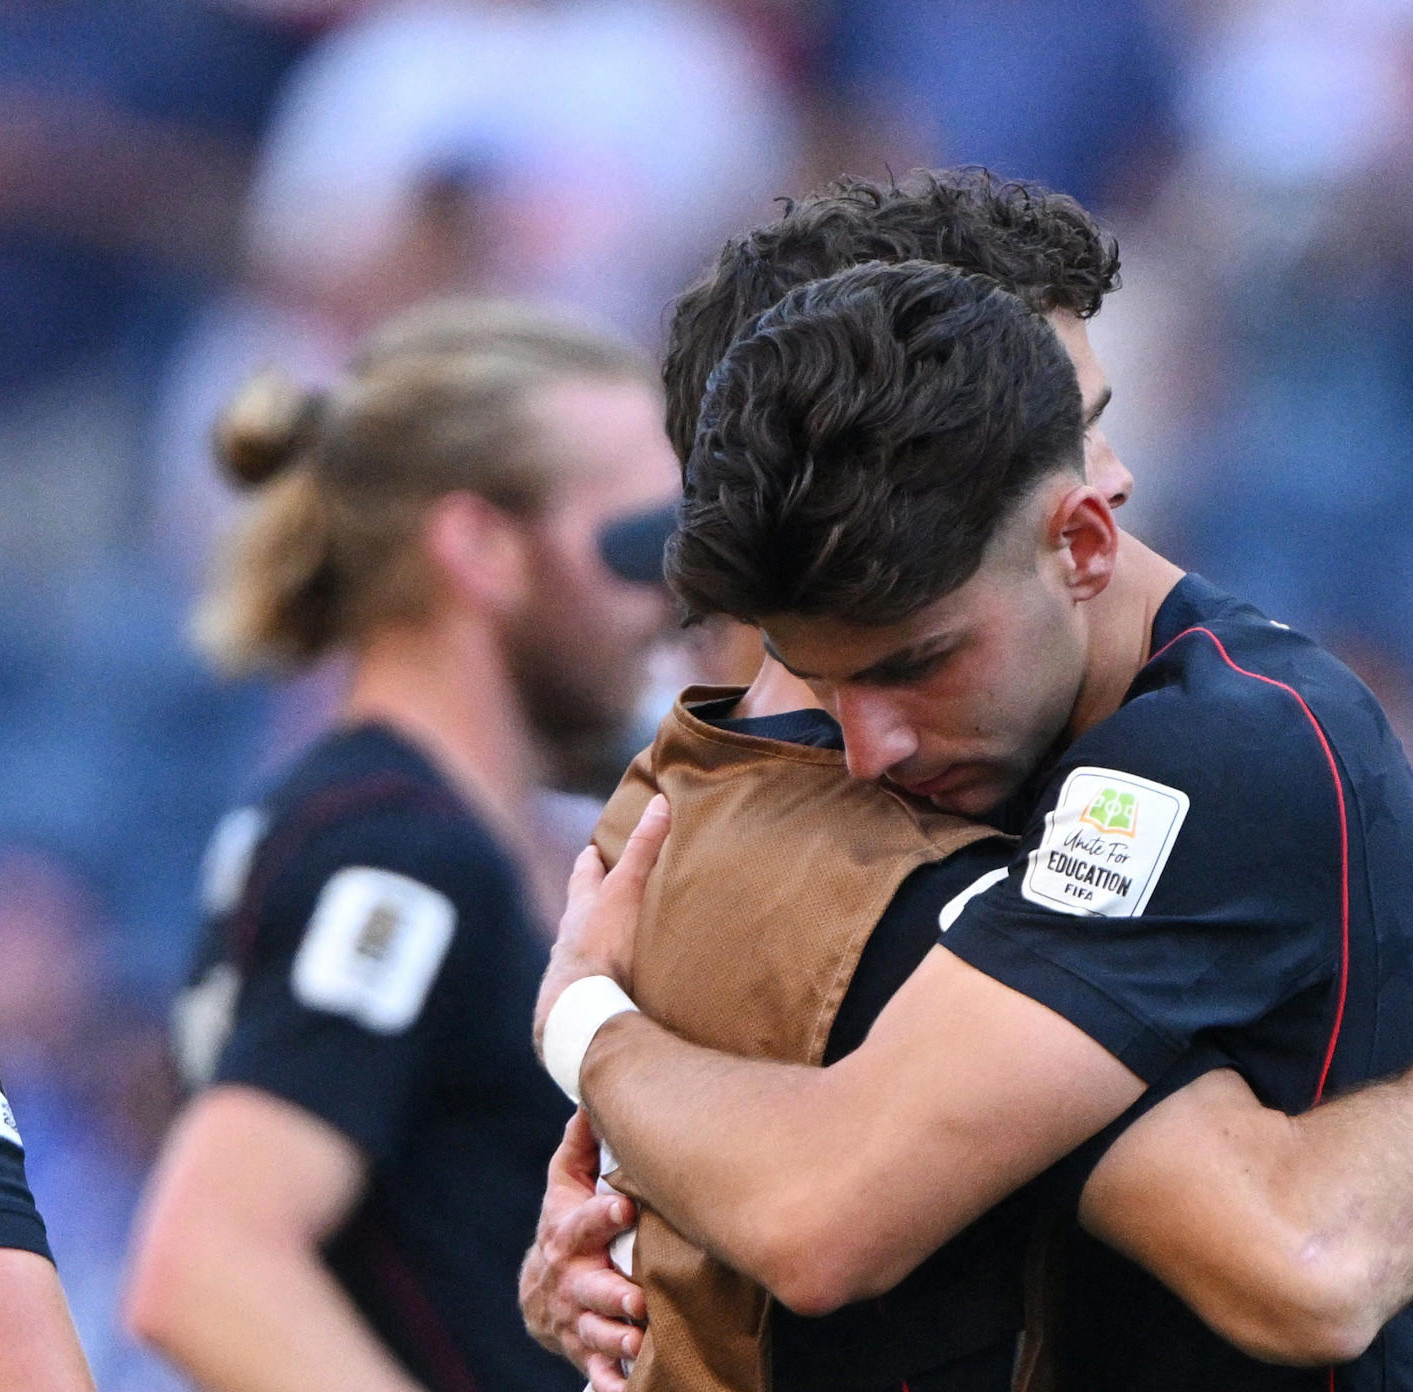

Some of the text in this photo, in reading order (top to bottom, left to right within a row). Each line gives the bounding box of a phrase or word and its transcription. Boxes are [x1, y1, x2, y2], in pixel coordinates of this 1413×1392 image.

[1063, 828, 1130, 864] Unite For
[1047, 850, 1133, 897] EDUCATION
[1064, 883, 1094, 901] FIFA
